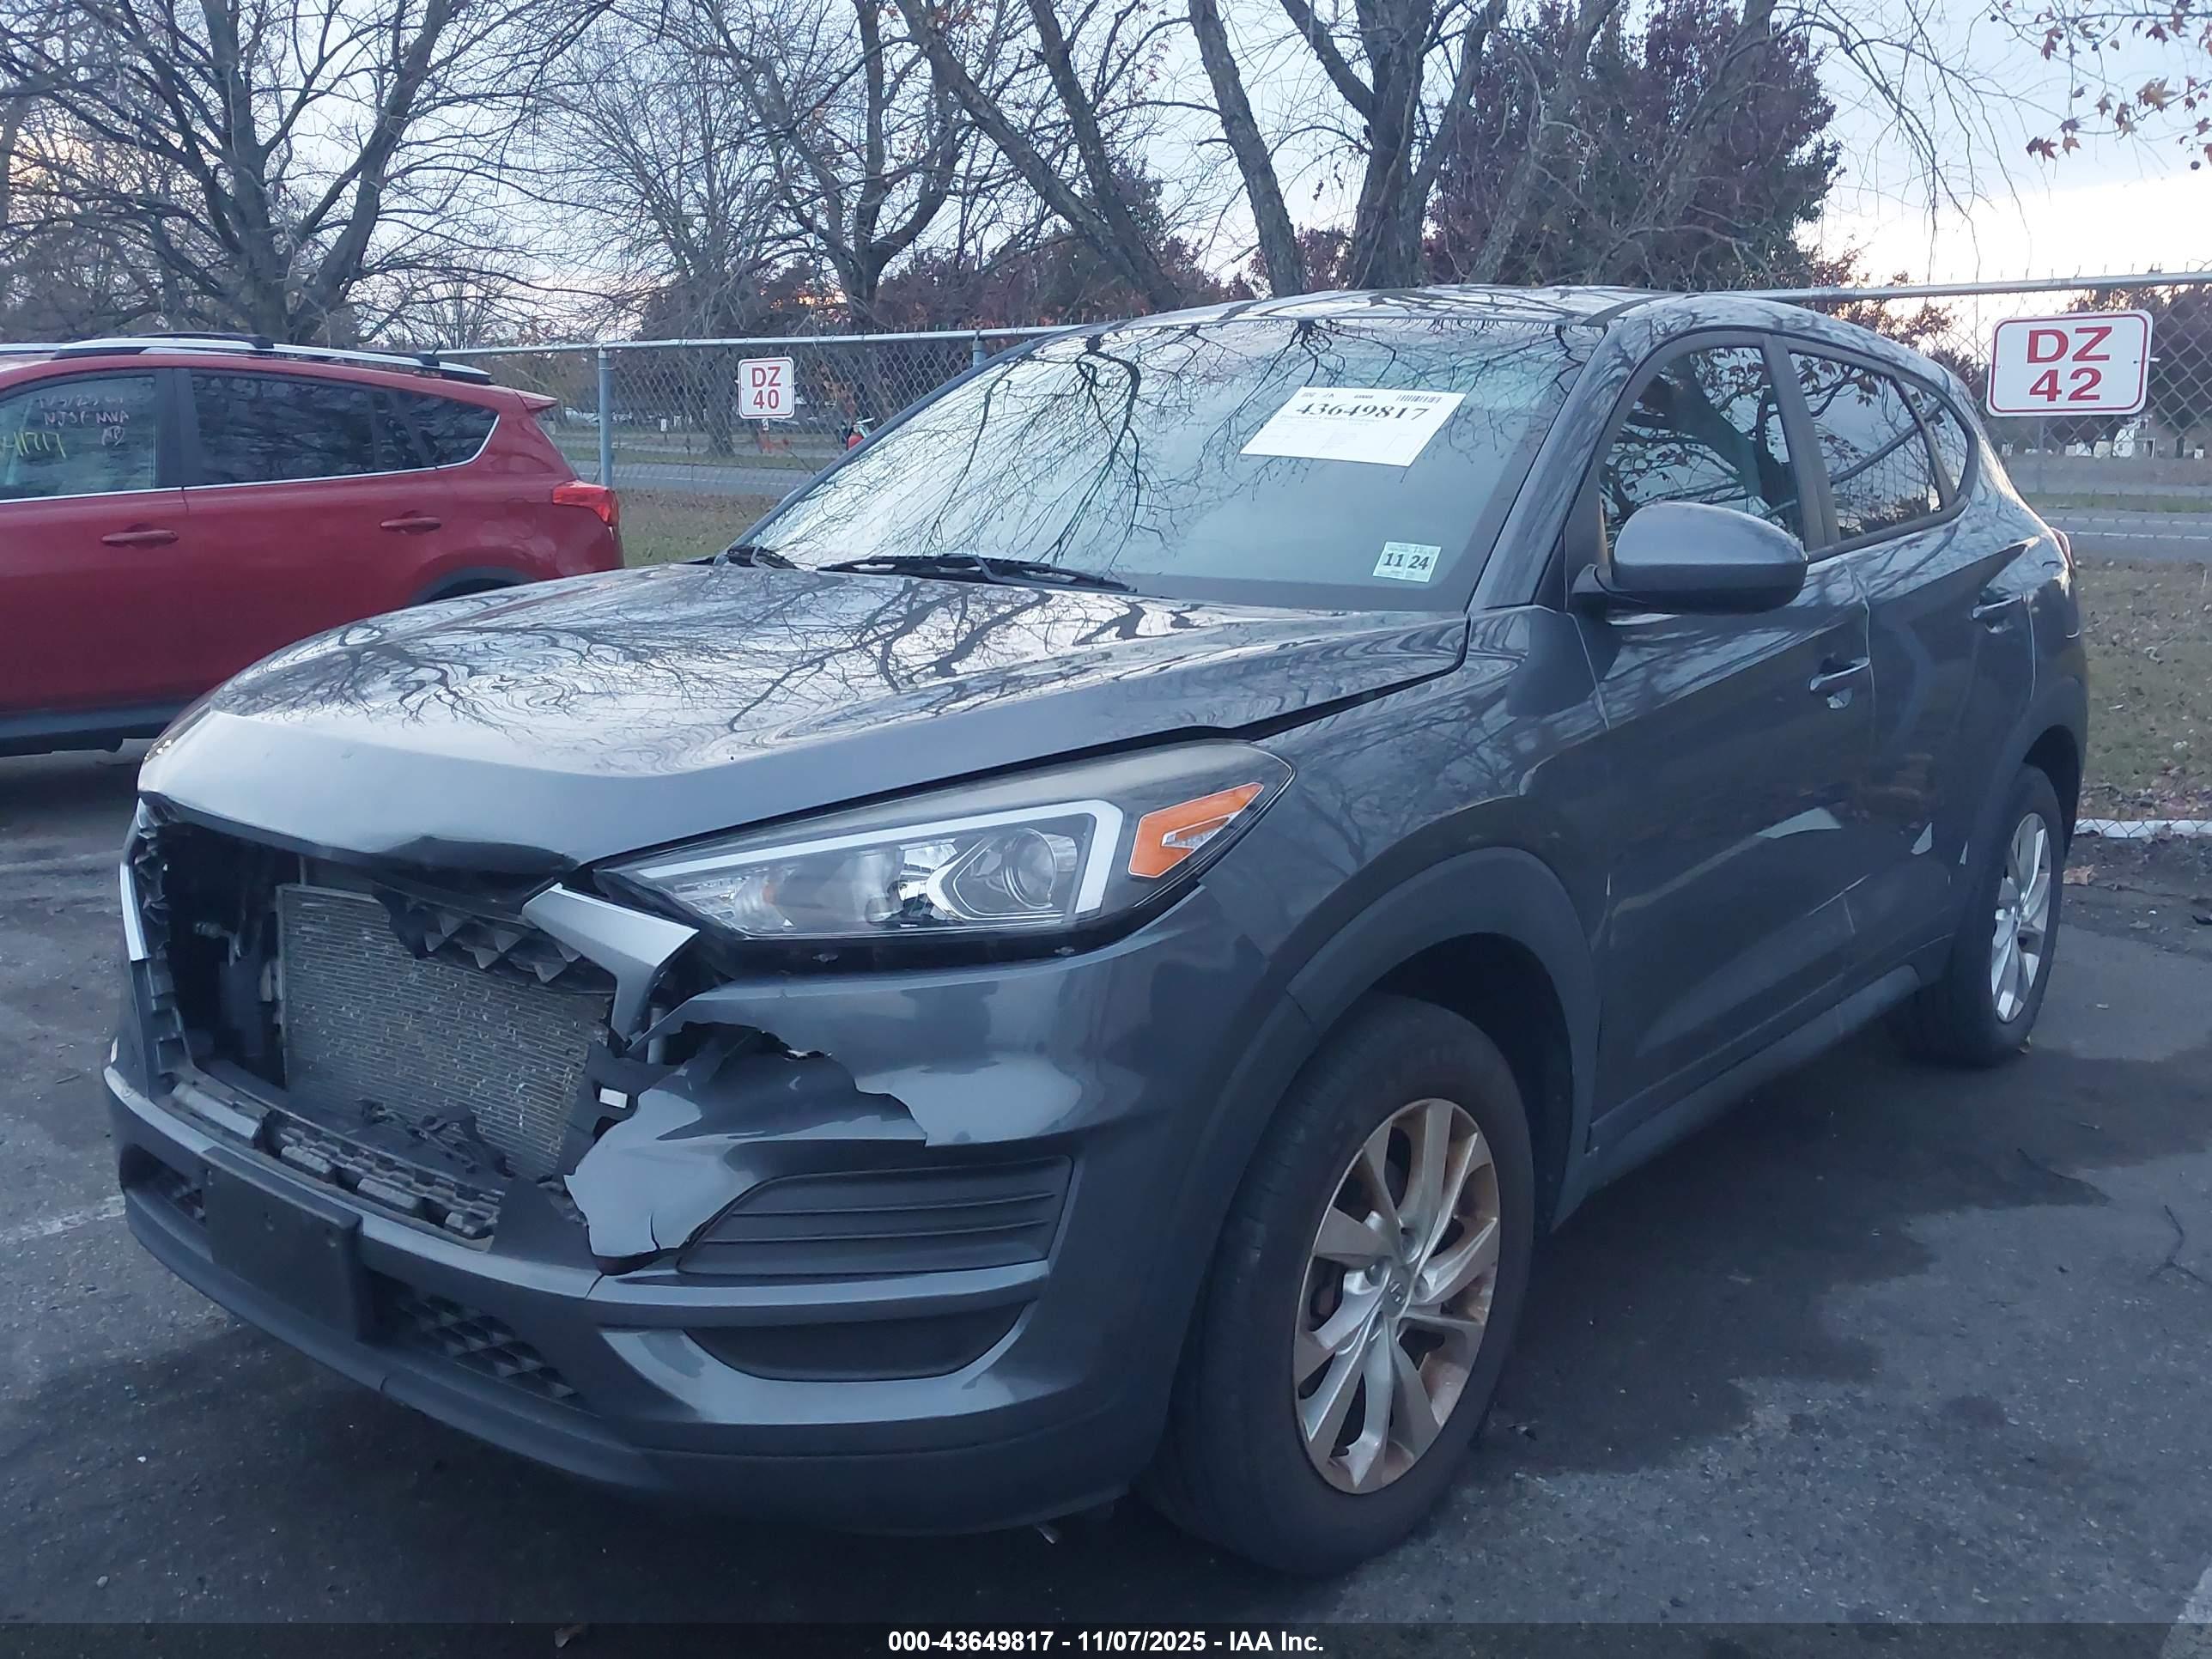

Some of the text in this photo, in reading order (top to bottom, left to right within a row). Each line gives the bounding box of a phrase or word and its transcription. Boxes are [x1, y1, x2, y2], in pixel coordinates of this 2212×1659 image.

[2027, 326, 2112, 363] DZ
[751, 366, 781, 388] DZ
[2029, 368, 2102, 402] 42
[753, 389, 780, 410] 40
[1295, 402, 1431, 421] 43649817
[1383, 553, 1430, 569] 11 24
